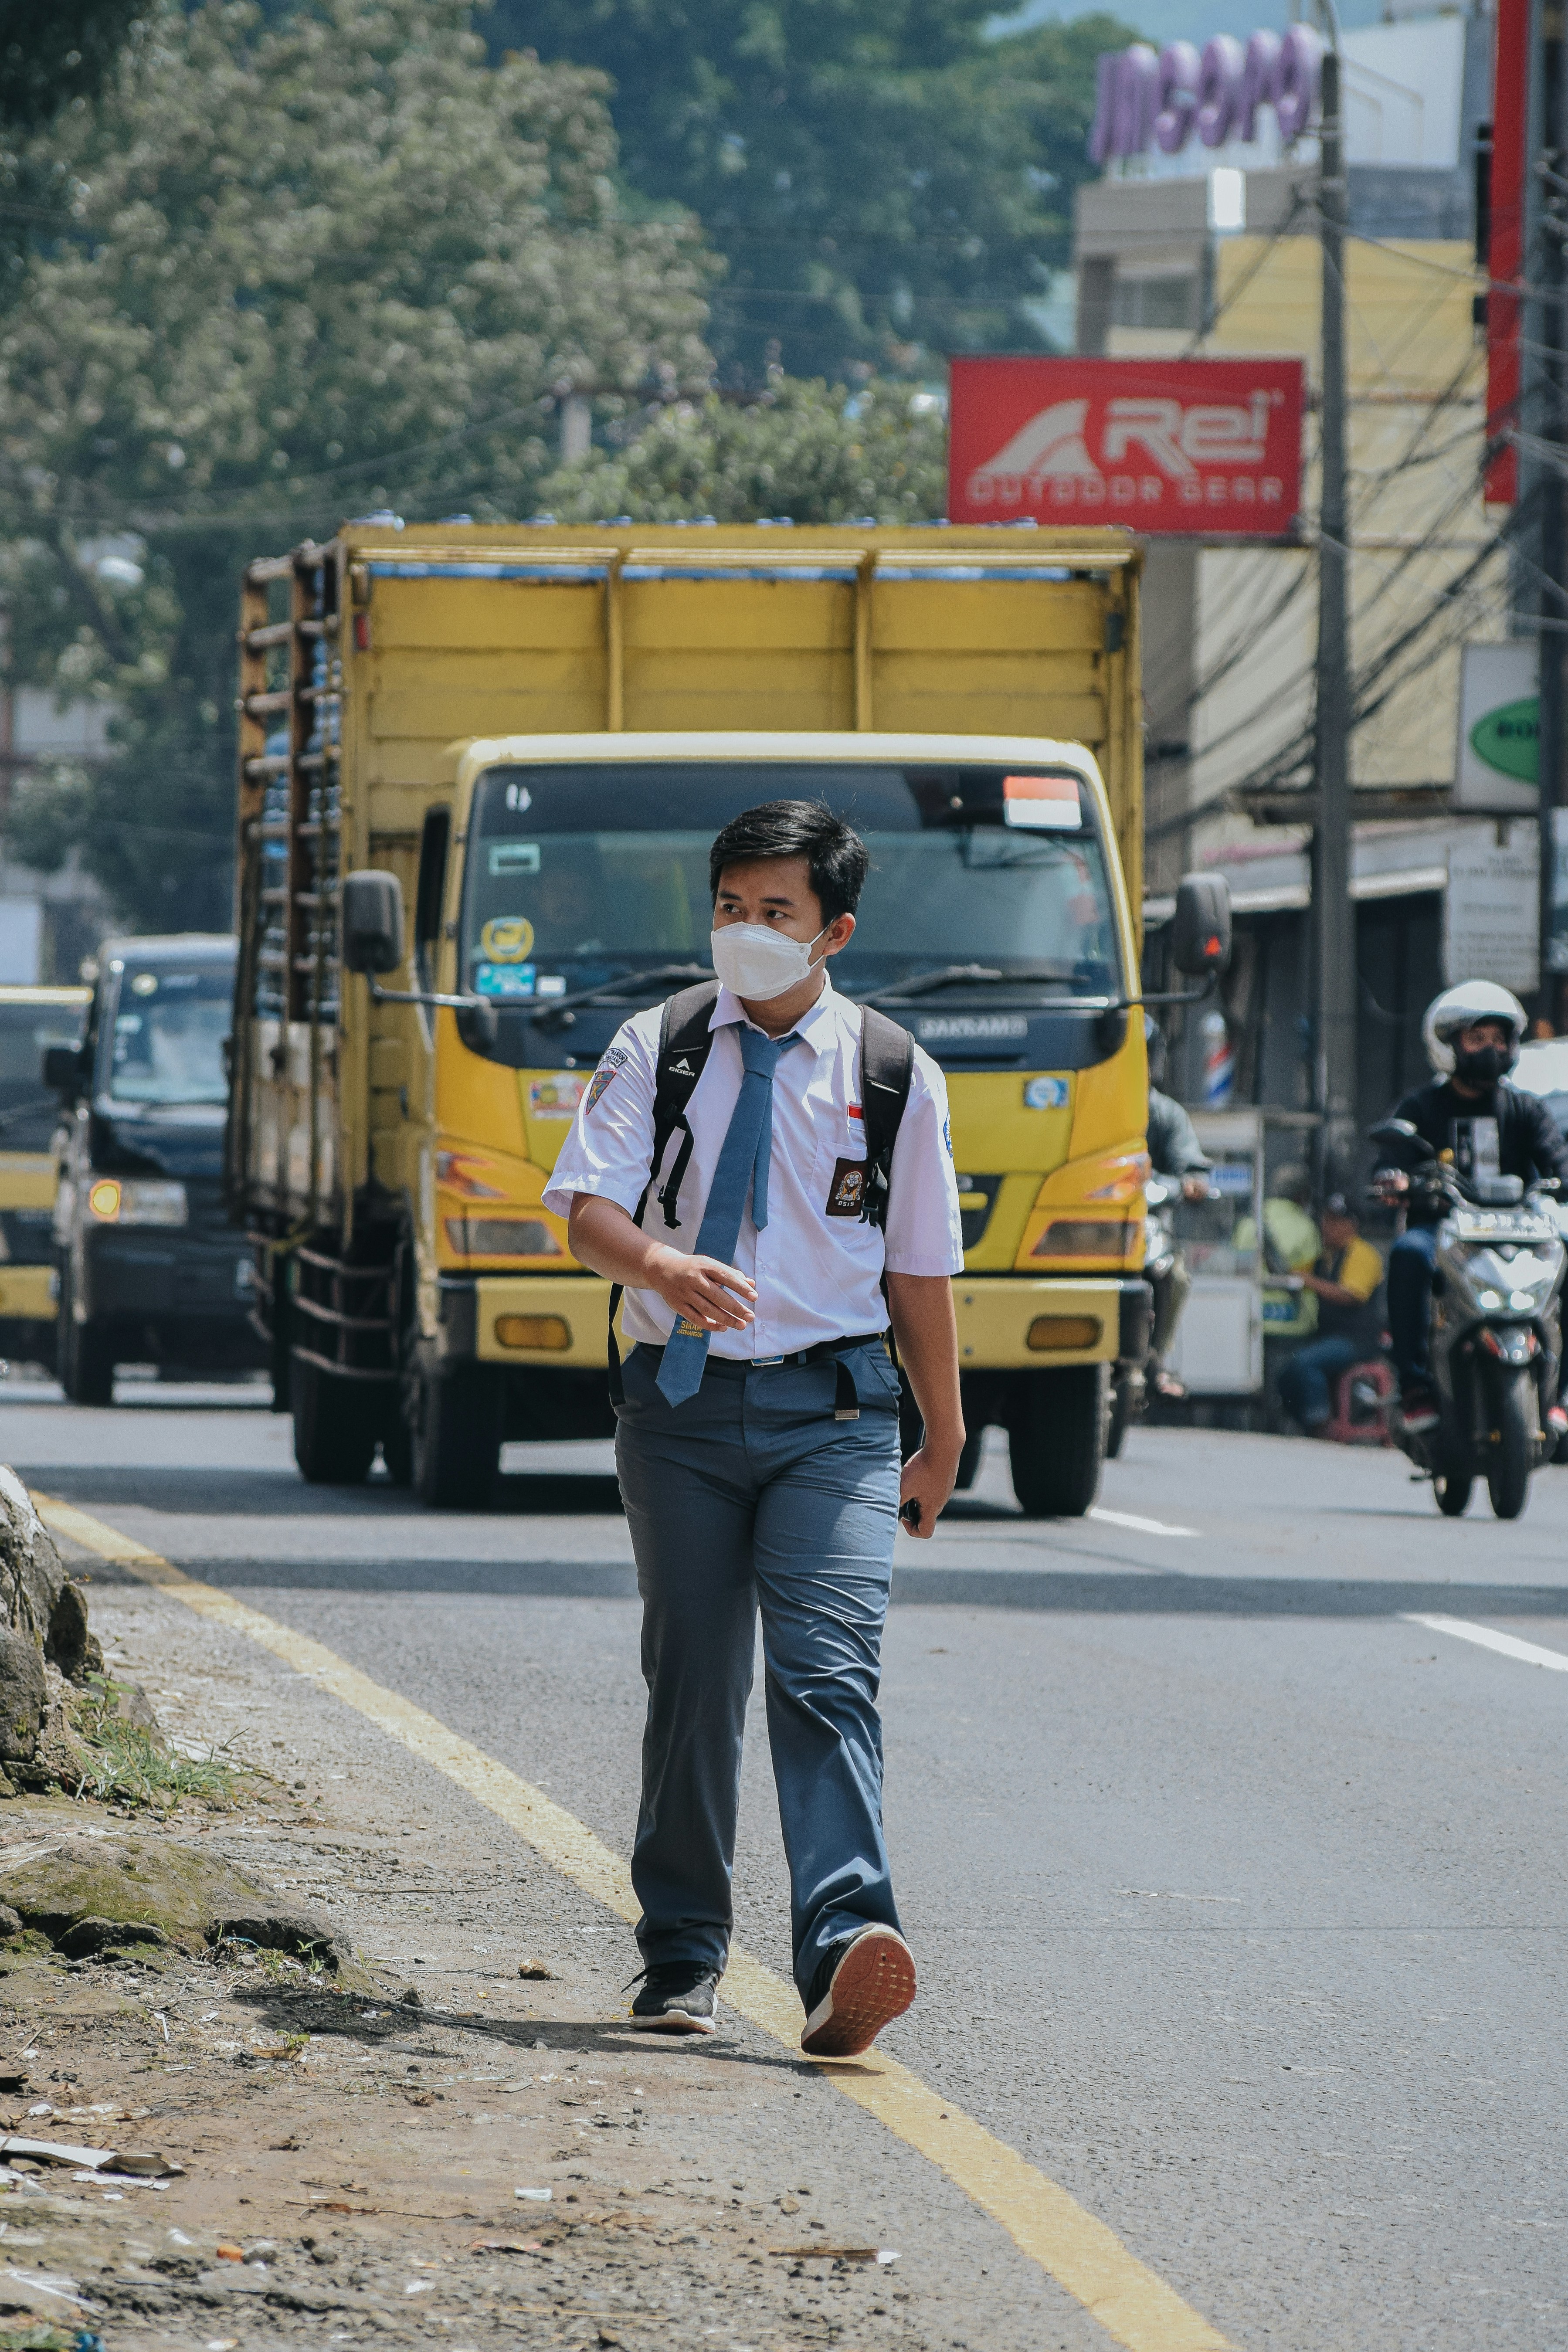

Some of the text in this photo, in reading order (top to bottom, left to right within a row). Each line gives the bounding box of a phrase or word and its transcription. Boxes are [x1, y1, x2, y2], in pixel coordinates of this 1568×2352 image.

[1103, 389, 1269, 478] Rei
[967, 474, 1284, 506] OUTDOOR GEAR
[669, 1066, 695, 1077] EIGER
